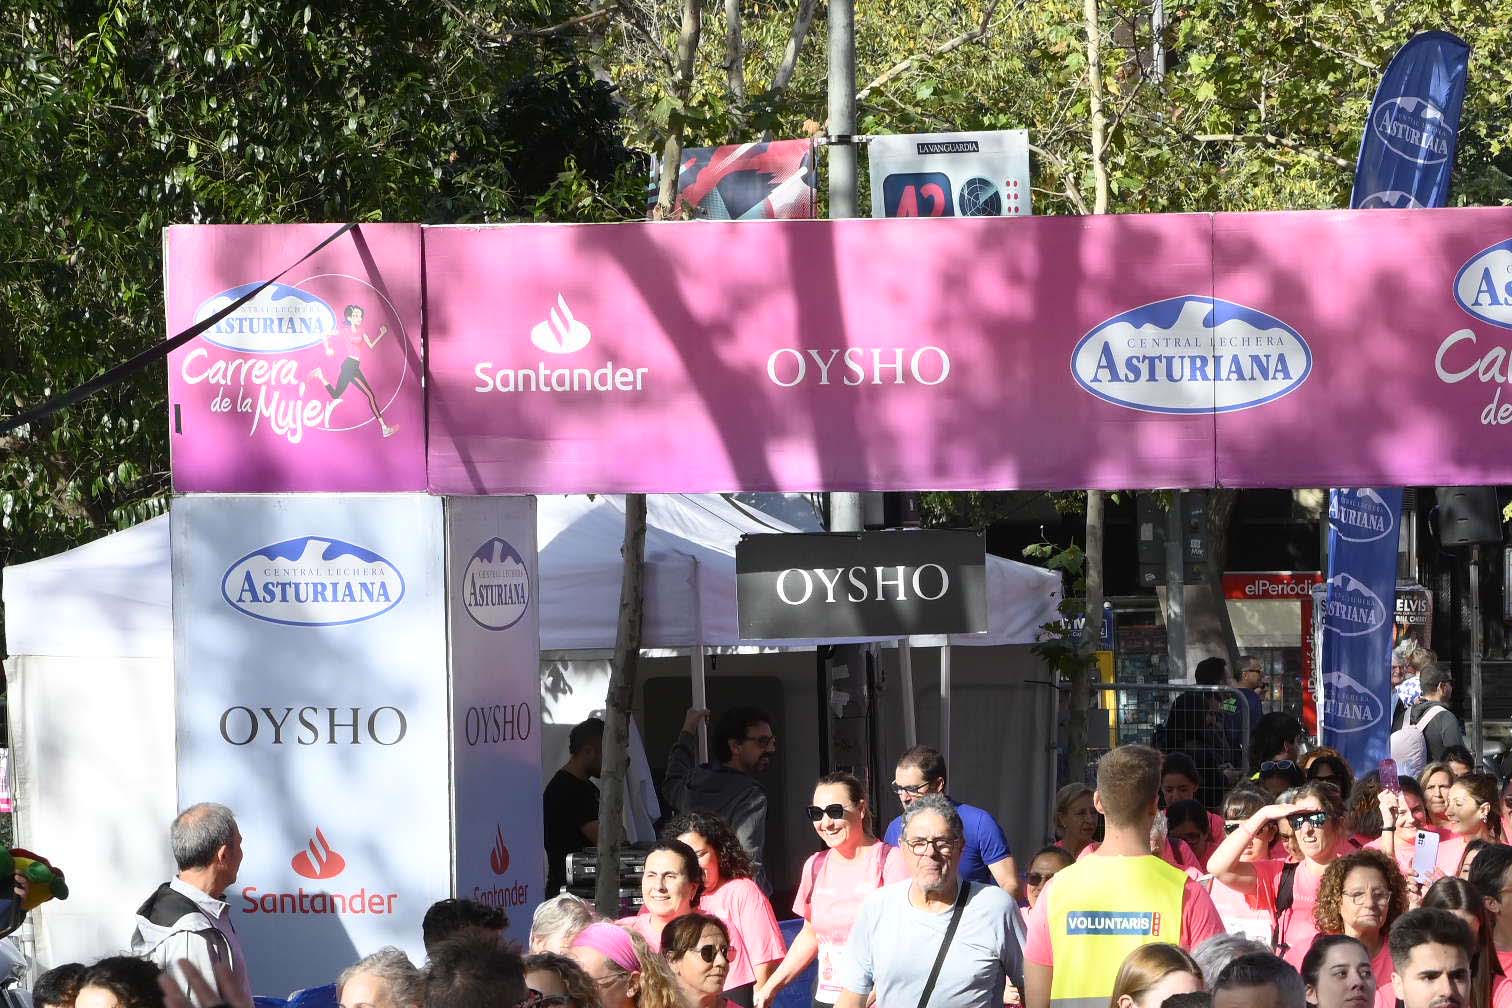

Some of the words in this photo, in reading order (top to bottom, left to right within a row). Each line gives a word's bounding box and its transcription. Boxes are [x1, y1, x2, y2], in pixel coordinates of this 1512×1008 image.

[1127, 337, 1202, 349] CENTRAL
[1209, 336, 1285, 347] LECHERA
[181, 348, 298, 386] Carrera
[474, 361, 649, 393] Santander
[766, 346, 951, 388] OYSHO
[1089, 341, 1293, 383] ASTURIANA
[210, 387, 233, 413] de
[237, 387, 252, 413] la
[249, 383, 344, 444] Mujer
[238, 570, 391, 604] ASTURIANA
[264, 567, 322, 577] CENTRAL
[328, 567, 386, 577] LECHERA
[468, 572, 526, 607] ASTURIANA
[776, 563, 950, 605] OYSHO
[1396, 599, 1428, 612] ELVIS
[219, 705, 408, 746] OYSHO
[464, 702, 532, 746] OYSHO
[241, 886, 399, 915] Santander
[1068, 914, 1150, 930] VOLUNTARIS
